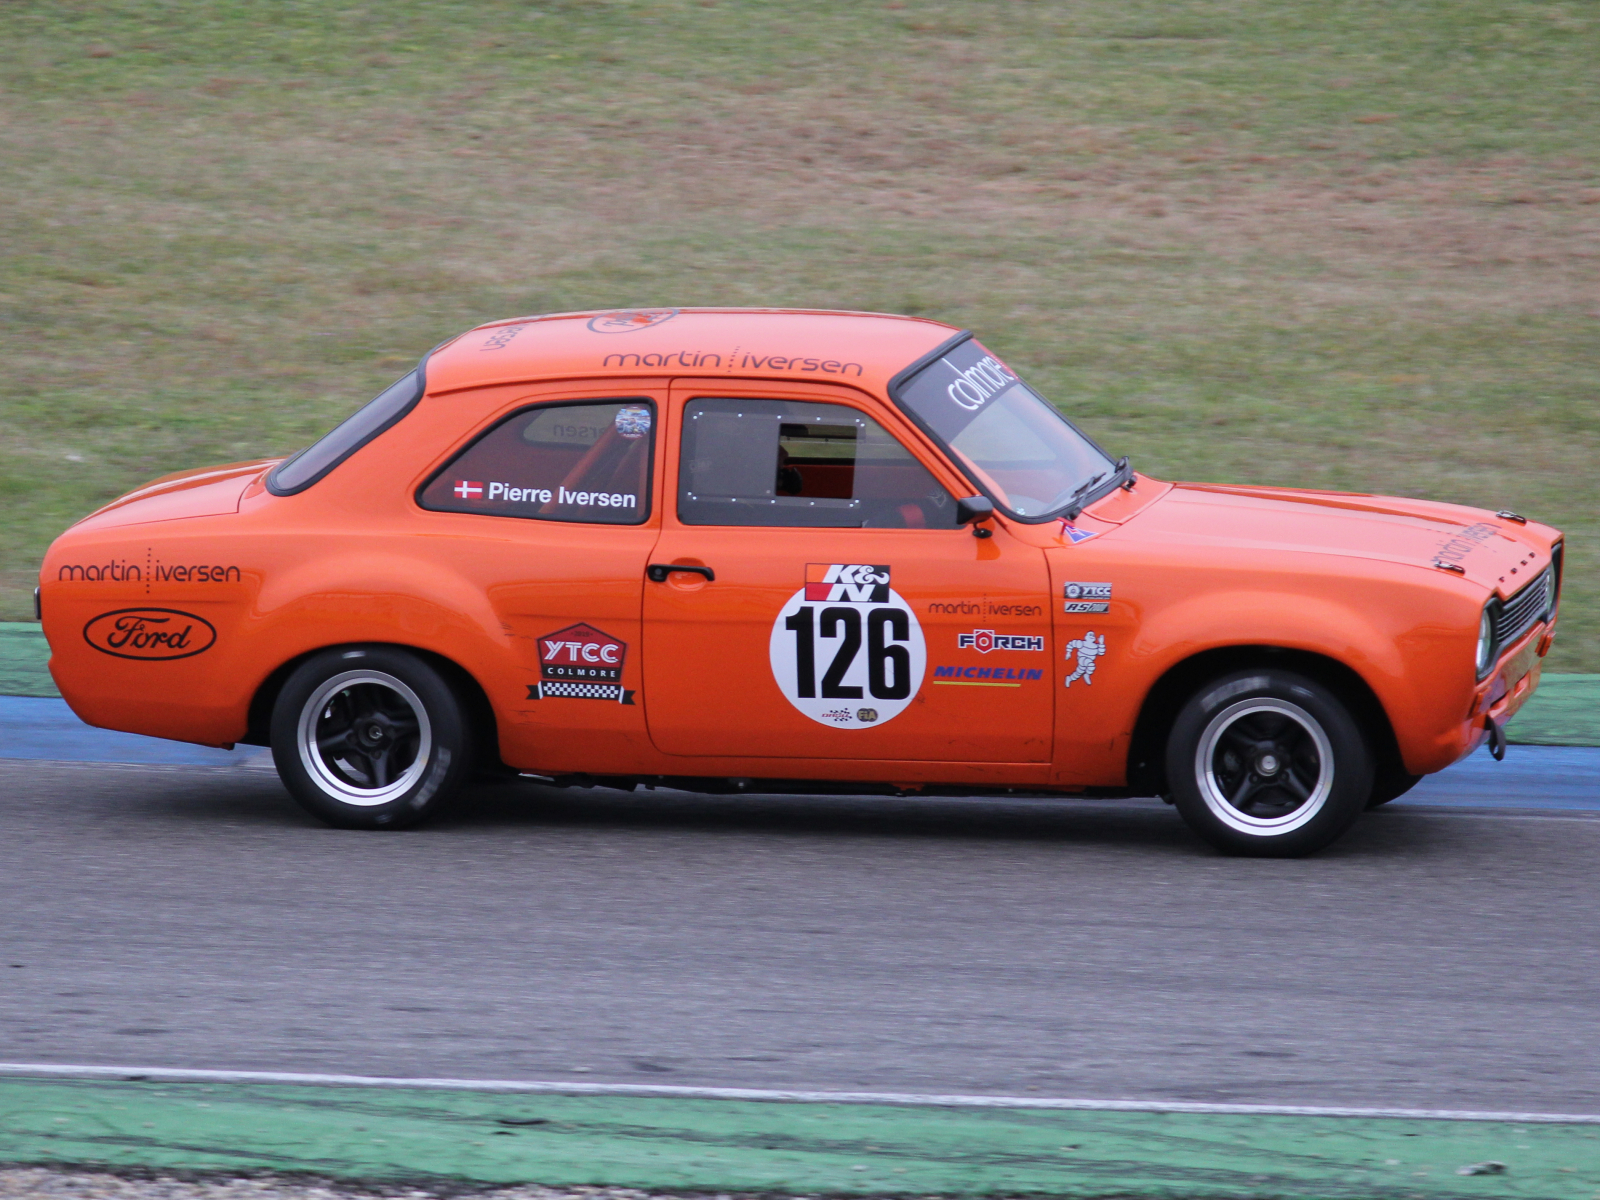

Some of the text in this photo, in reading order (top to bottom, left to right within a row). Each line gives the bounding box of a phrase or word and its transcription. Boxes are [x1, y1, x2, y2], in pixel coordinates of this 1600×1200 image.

[603, 350, 864, 376] martin iversen
[488, 481, 636, 508] Pierre Iversen
[59, 559, 241, 582] martin iversen
[928, 601, 1042, 616] martin iversen
[107, 615, 193, 649] Ford
[543, 640, 619, 663] YTCC
[785, 606, 911, 700] 126
[547, 667, 616, 678] COLMORE
[933, 666, 1044, 680] MICHELIN
